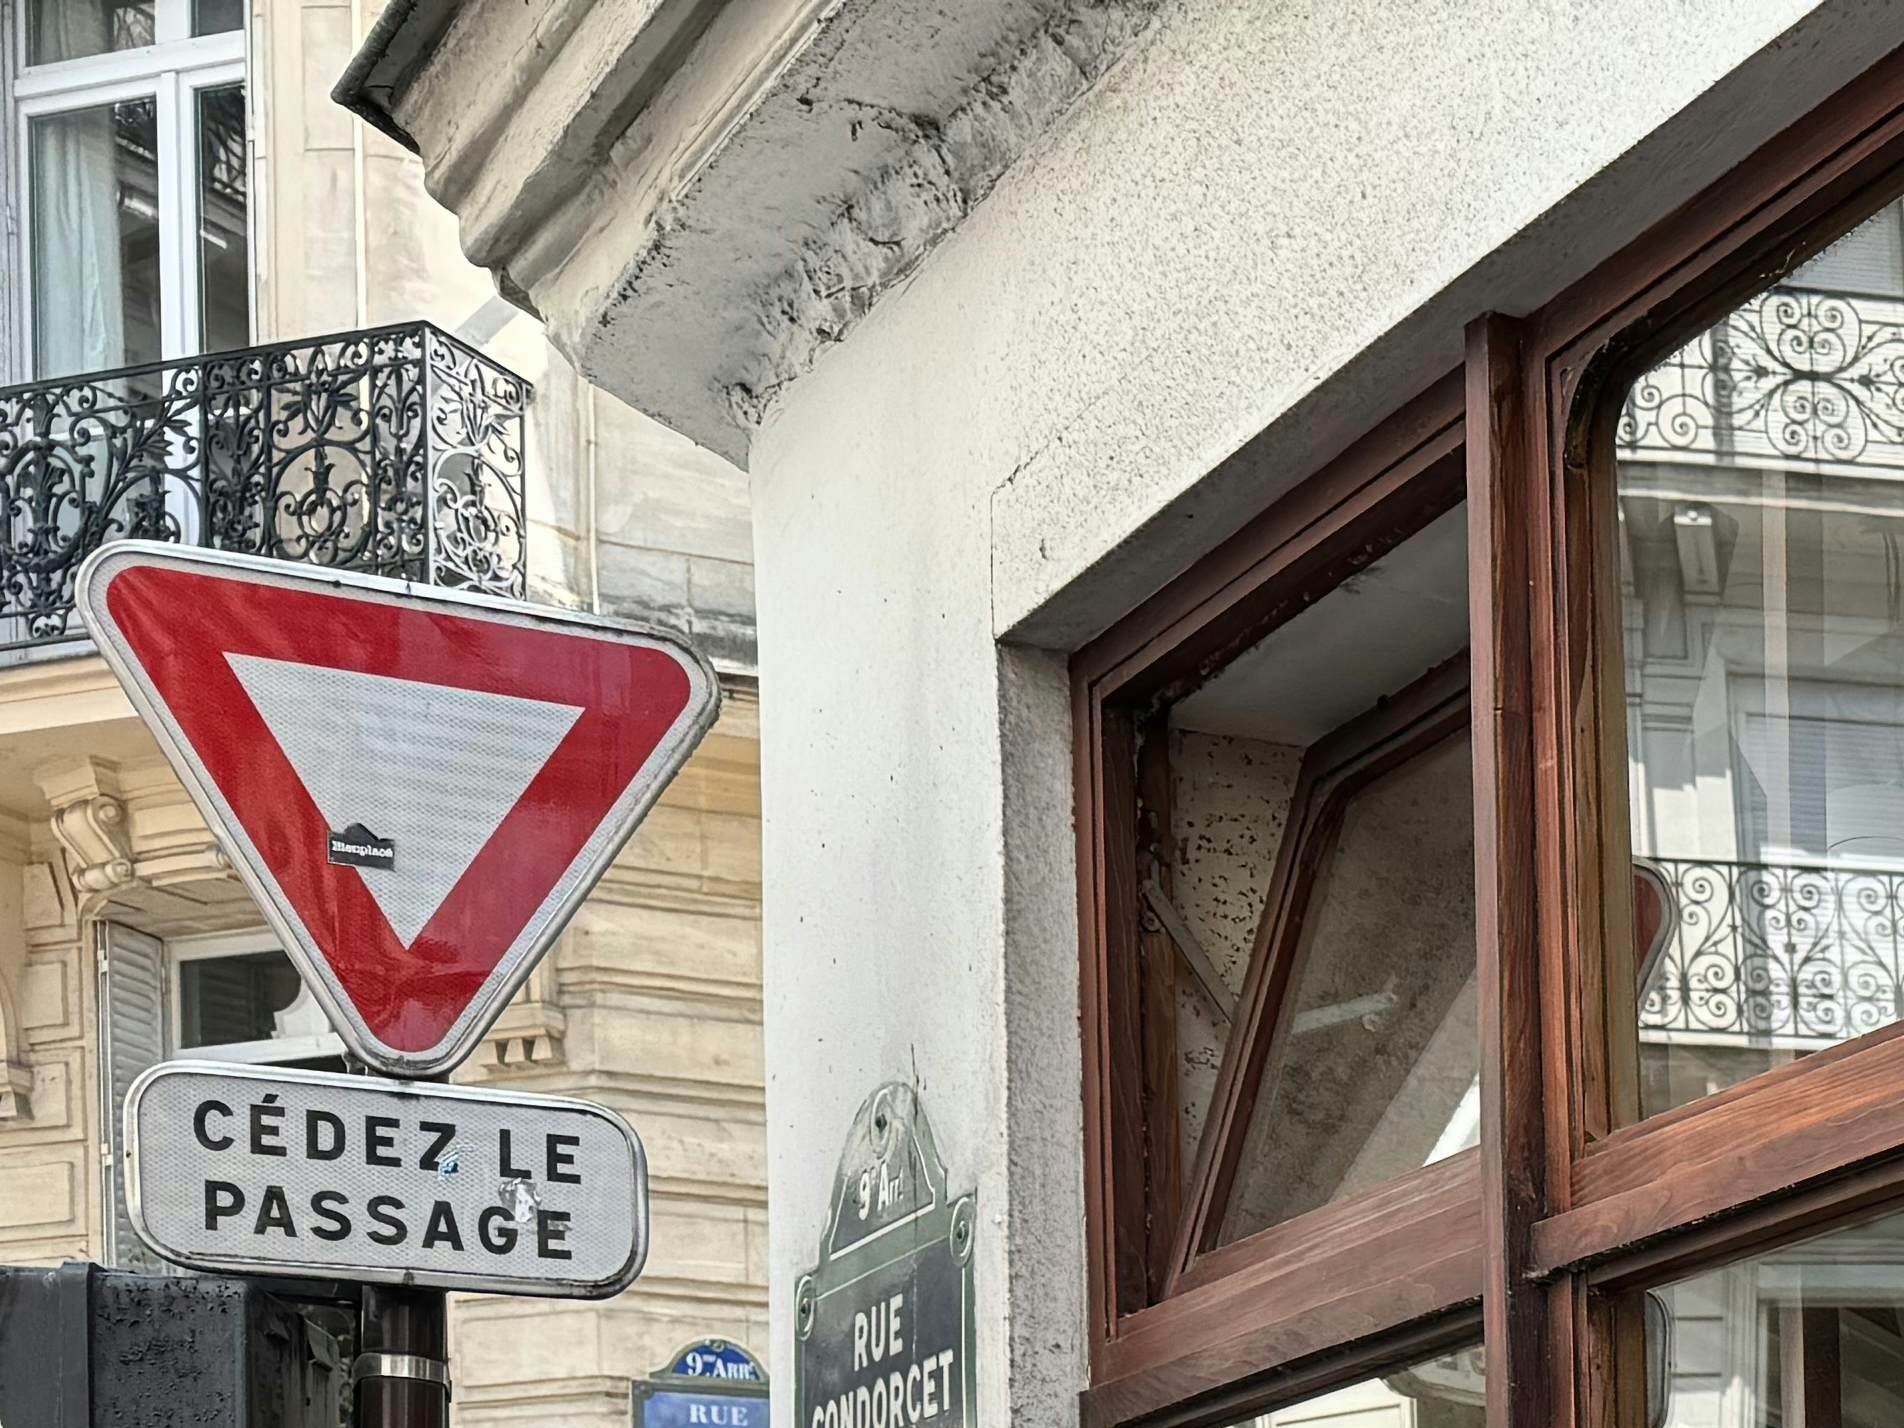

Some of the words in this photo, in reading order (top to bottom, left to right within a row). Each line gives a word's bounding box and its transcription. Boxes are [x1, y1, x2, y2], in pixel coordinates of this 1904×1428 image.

[193, 1093, 457, 1172] CÉDEZ
[499, 1128, 582, 1185] LE
[204, 1179, 574, 1260] PASSAGE
[854, 1293, 904, 1373] RUE
[690, 1404, 749, 1427] RUE
